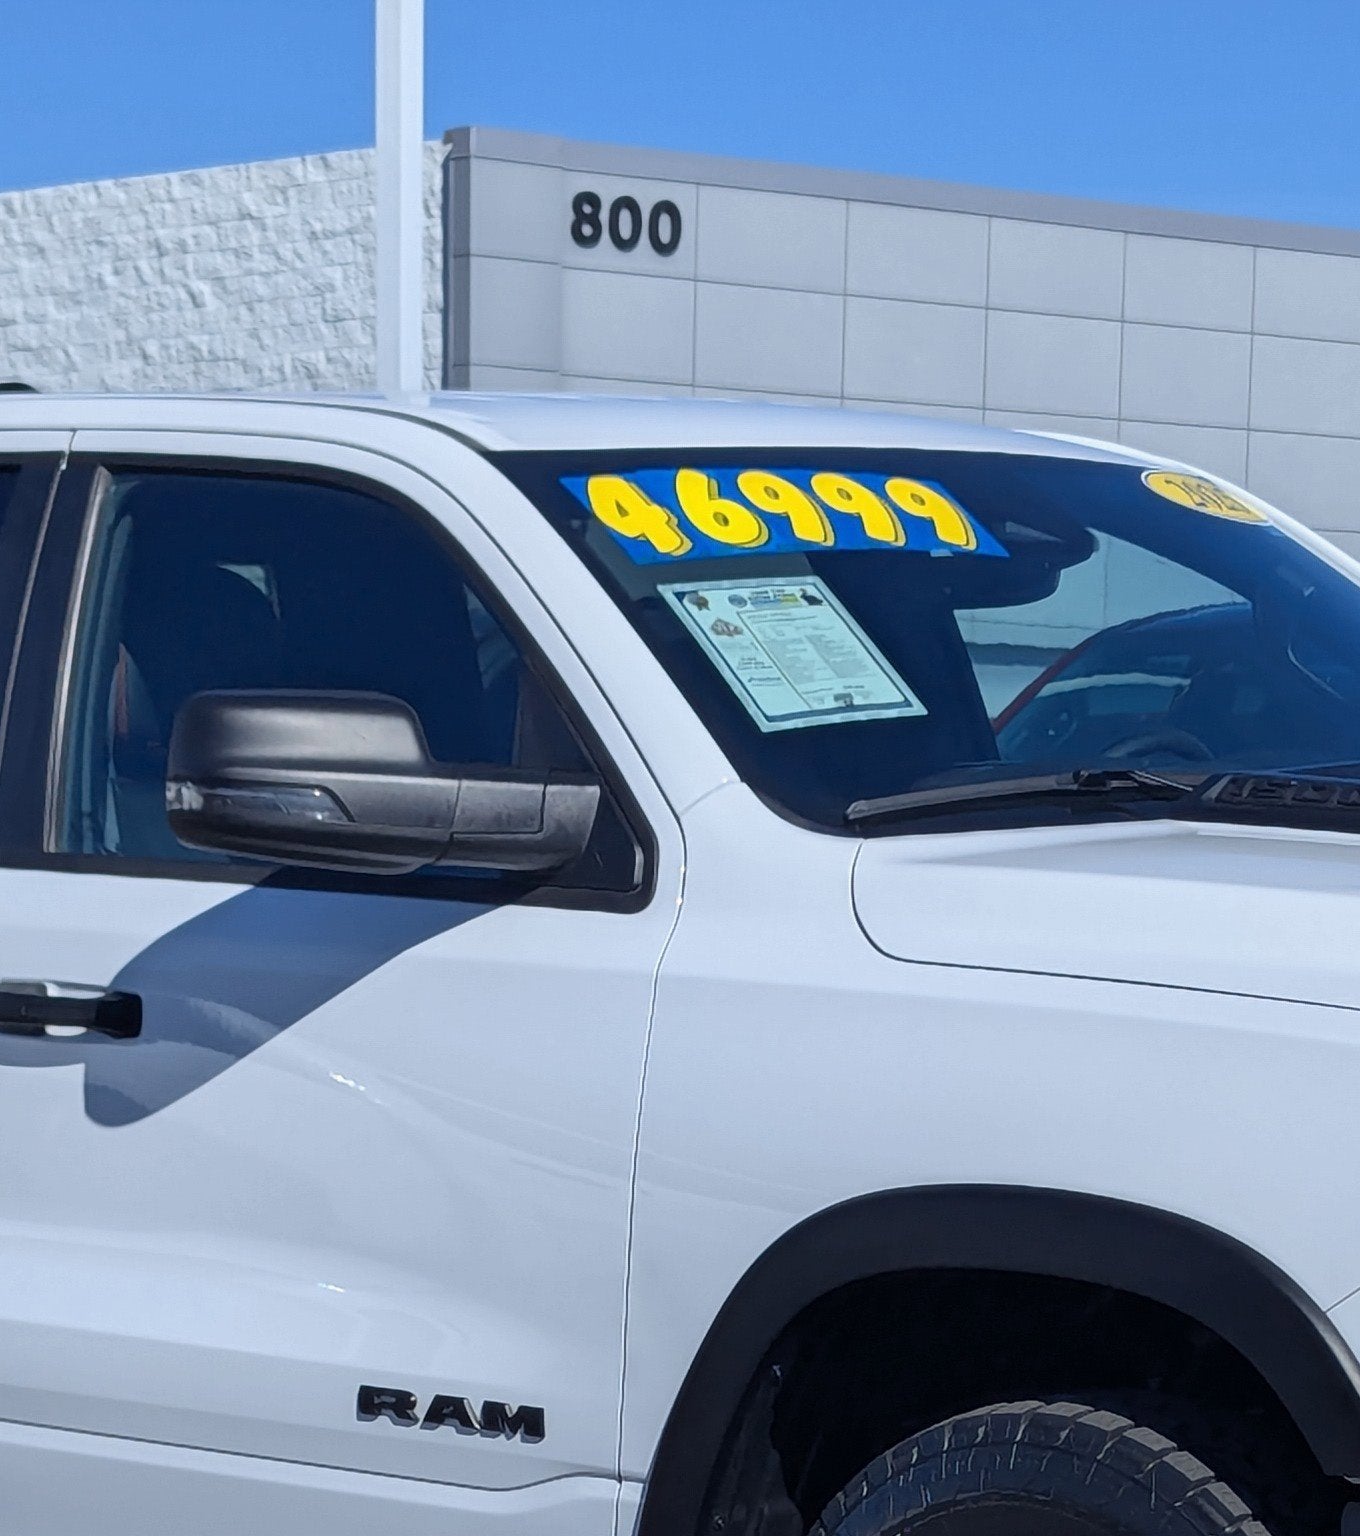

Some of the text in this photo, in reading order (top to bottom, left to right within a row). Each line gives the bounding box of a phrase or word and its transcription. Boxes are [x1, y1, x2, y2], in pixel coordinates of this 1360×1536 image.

[570, 190, 682, 257] 800
[586, 466, 977, 557] 46999
[356, 1384, 546, 1444] RAM
